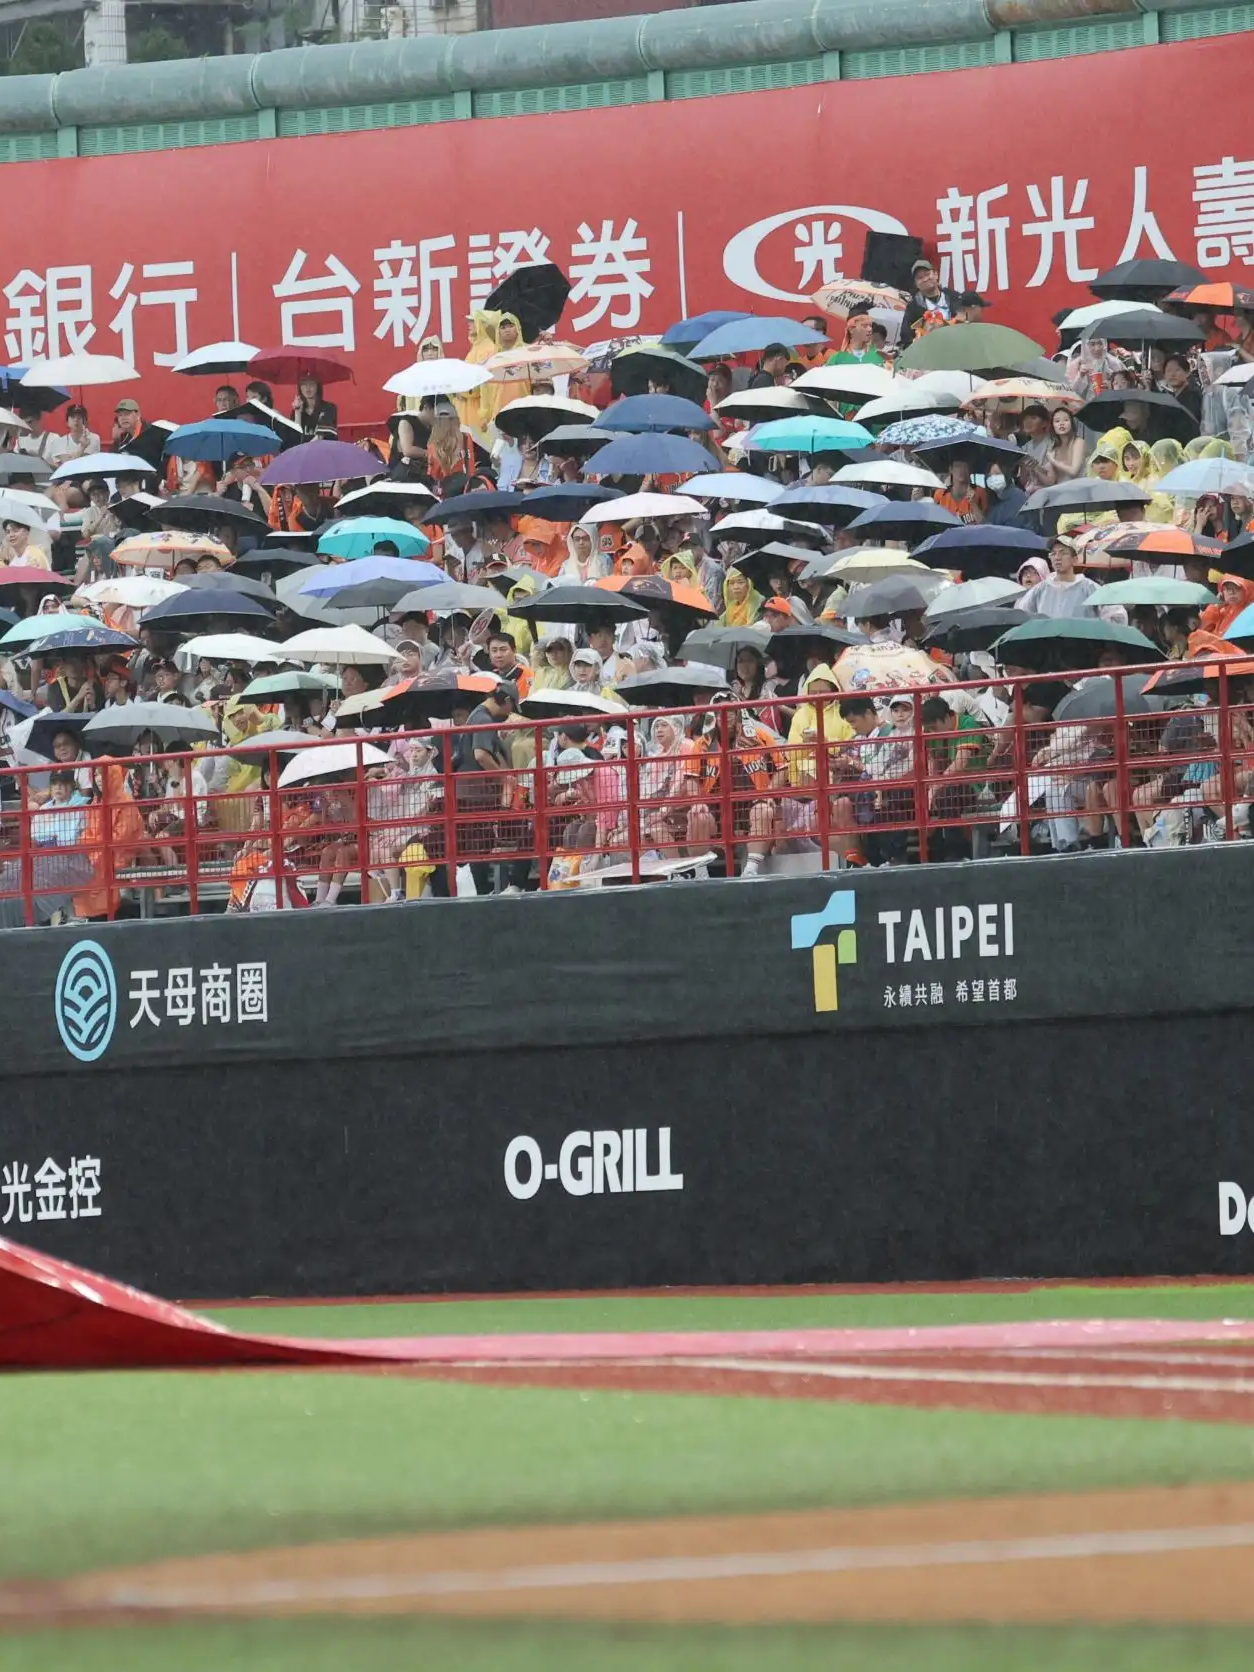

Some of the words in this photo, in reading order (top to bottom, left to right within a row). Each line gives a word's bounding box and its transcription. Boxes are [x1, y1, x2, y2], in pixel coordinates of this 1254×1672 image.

[878, 903, 1014, 963] TAIPEI
[128, 962, 268, 1029] 天母商圈
[883, 982, 945, 1008] 永續共融
[955, 978, 1018, 1003] 希望首都
[504, 1127, 683, 1200] O-GRILL
[1218, 1181, 1254, 1236] D
